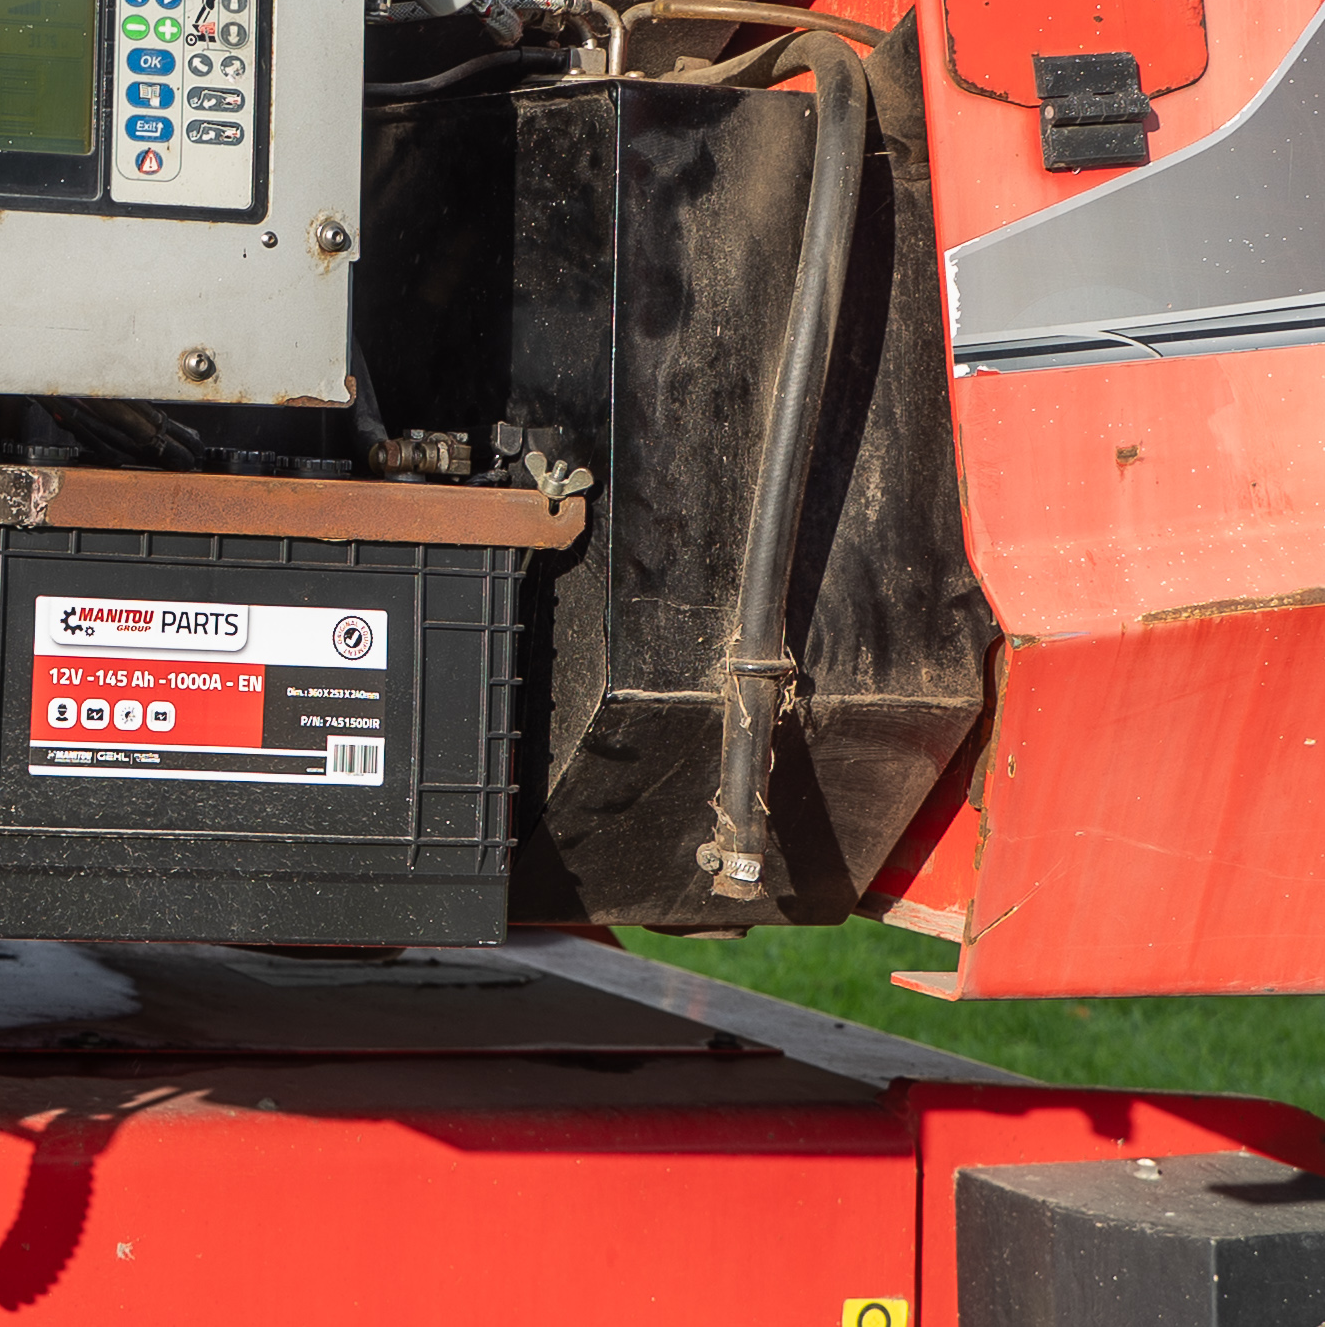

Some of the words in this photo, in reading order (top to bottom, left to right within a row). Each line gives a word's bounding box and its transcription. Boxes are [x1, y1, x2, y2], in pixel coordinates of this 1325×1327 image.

[140, 55, 162, 69] OK
[136, 121, 157, 132] Exit
[78, 608, 155, 623] MANITOU
[161, 611, 239, 636] PARTS
[117, 625, 152, 633] GROUP
[337, 621, 358, 644] ORIGINAL
[50, 668, 82, 685] 12V
[132, 671, 155, 688] Ah
[239, 675, 262, 692] EN
[301, 715, 323, 726] P/N:
[325, 717, 380, 729] 745150DIR
[97, 752, 129, 761] GEHL
